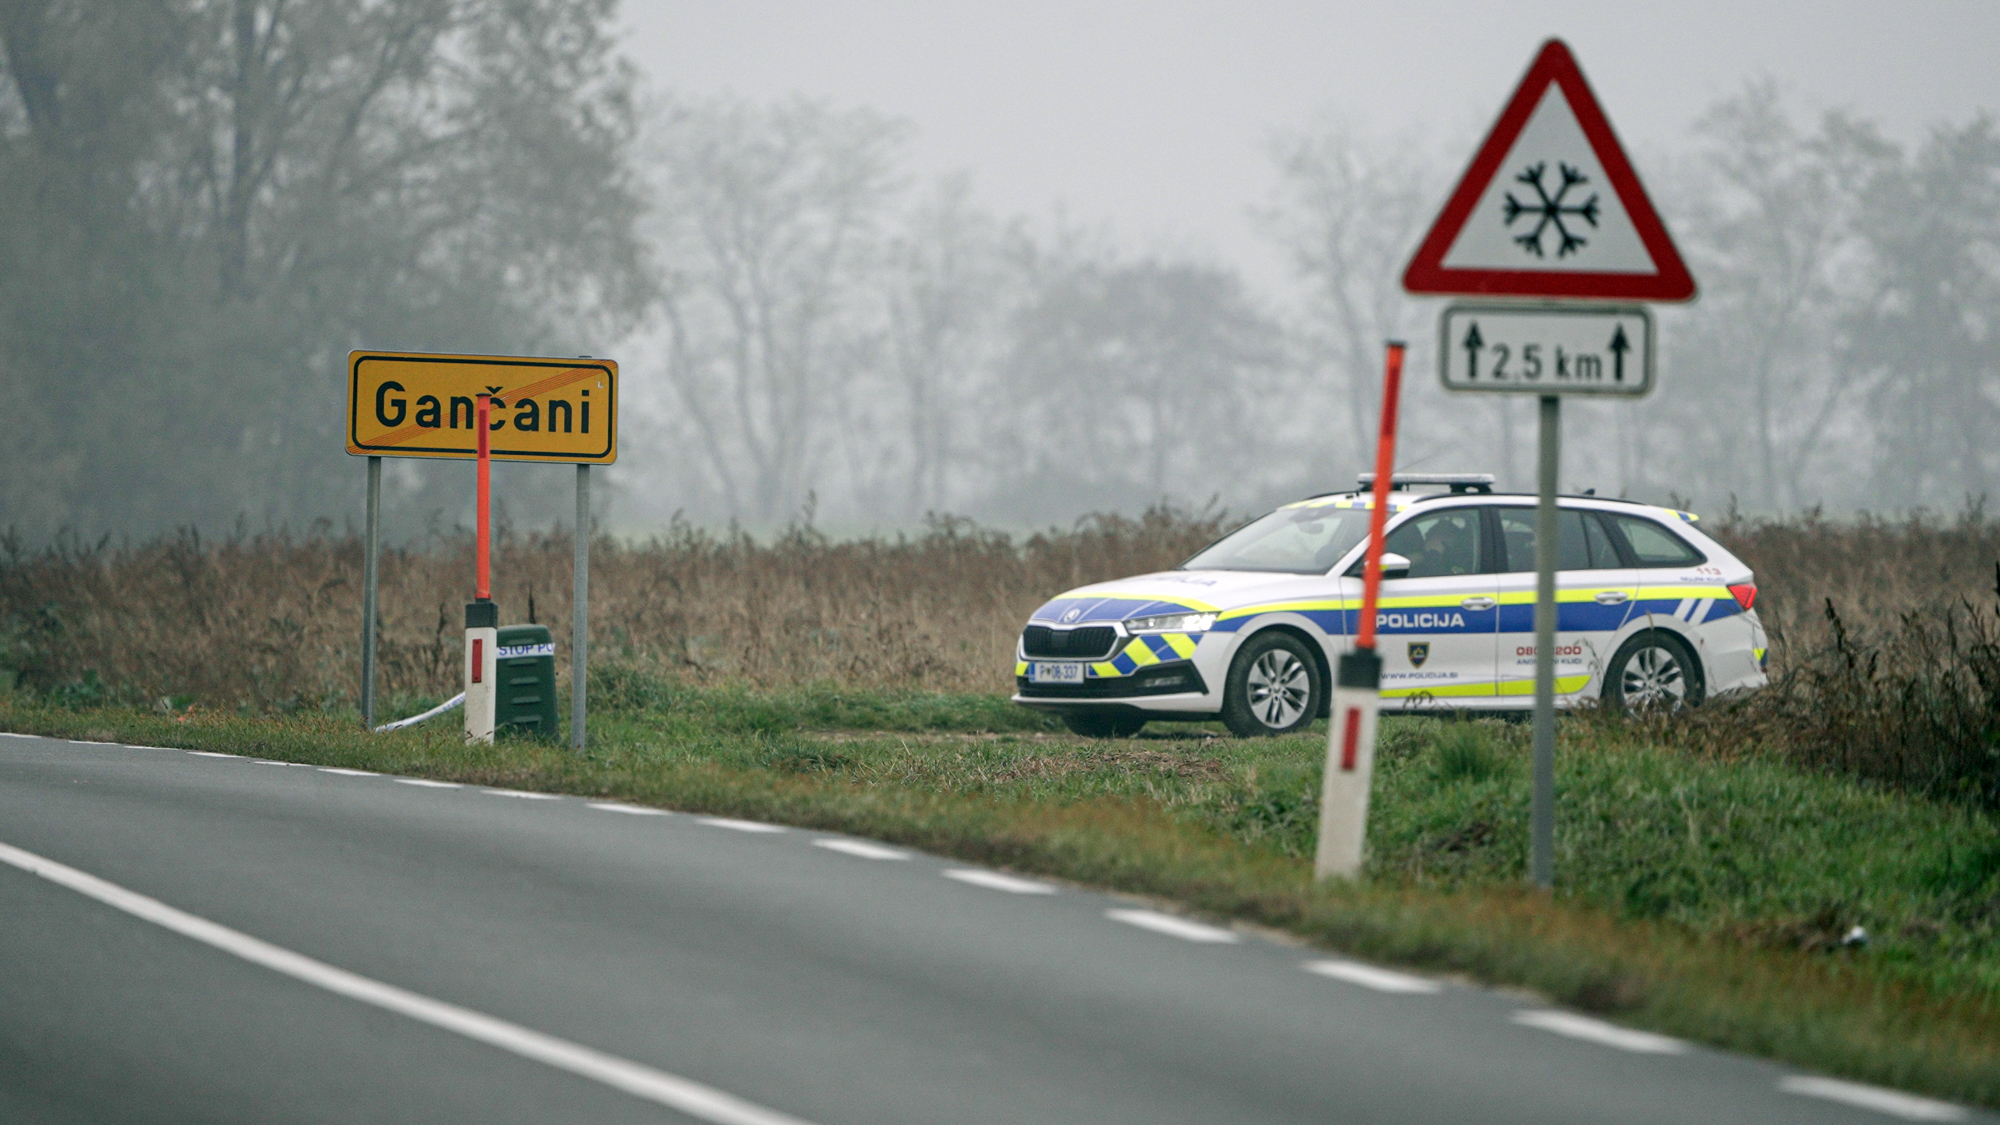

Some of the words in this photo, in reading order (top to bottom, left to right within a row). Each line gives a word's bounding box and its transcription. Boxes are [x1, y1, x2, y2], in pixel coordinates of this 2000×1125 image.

[1555, 345, 1602, 380] km
[375, 380, 590, 434] Gančani
[1696, 567, 1722, 576] 113
[1375, 613, 1465, 628] POLICIJA
[499, 645, 534, 656] STOP
